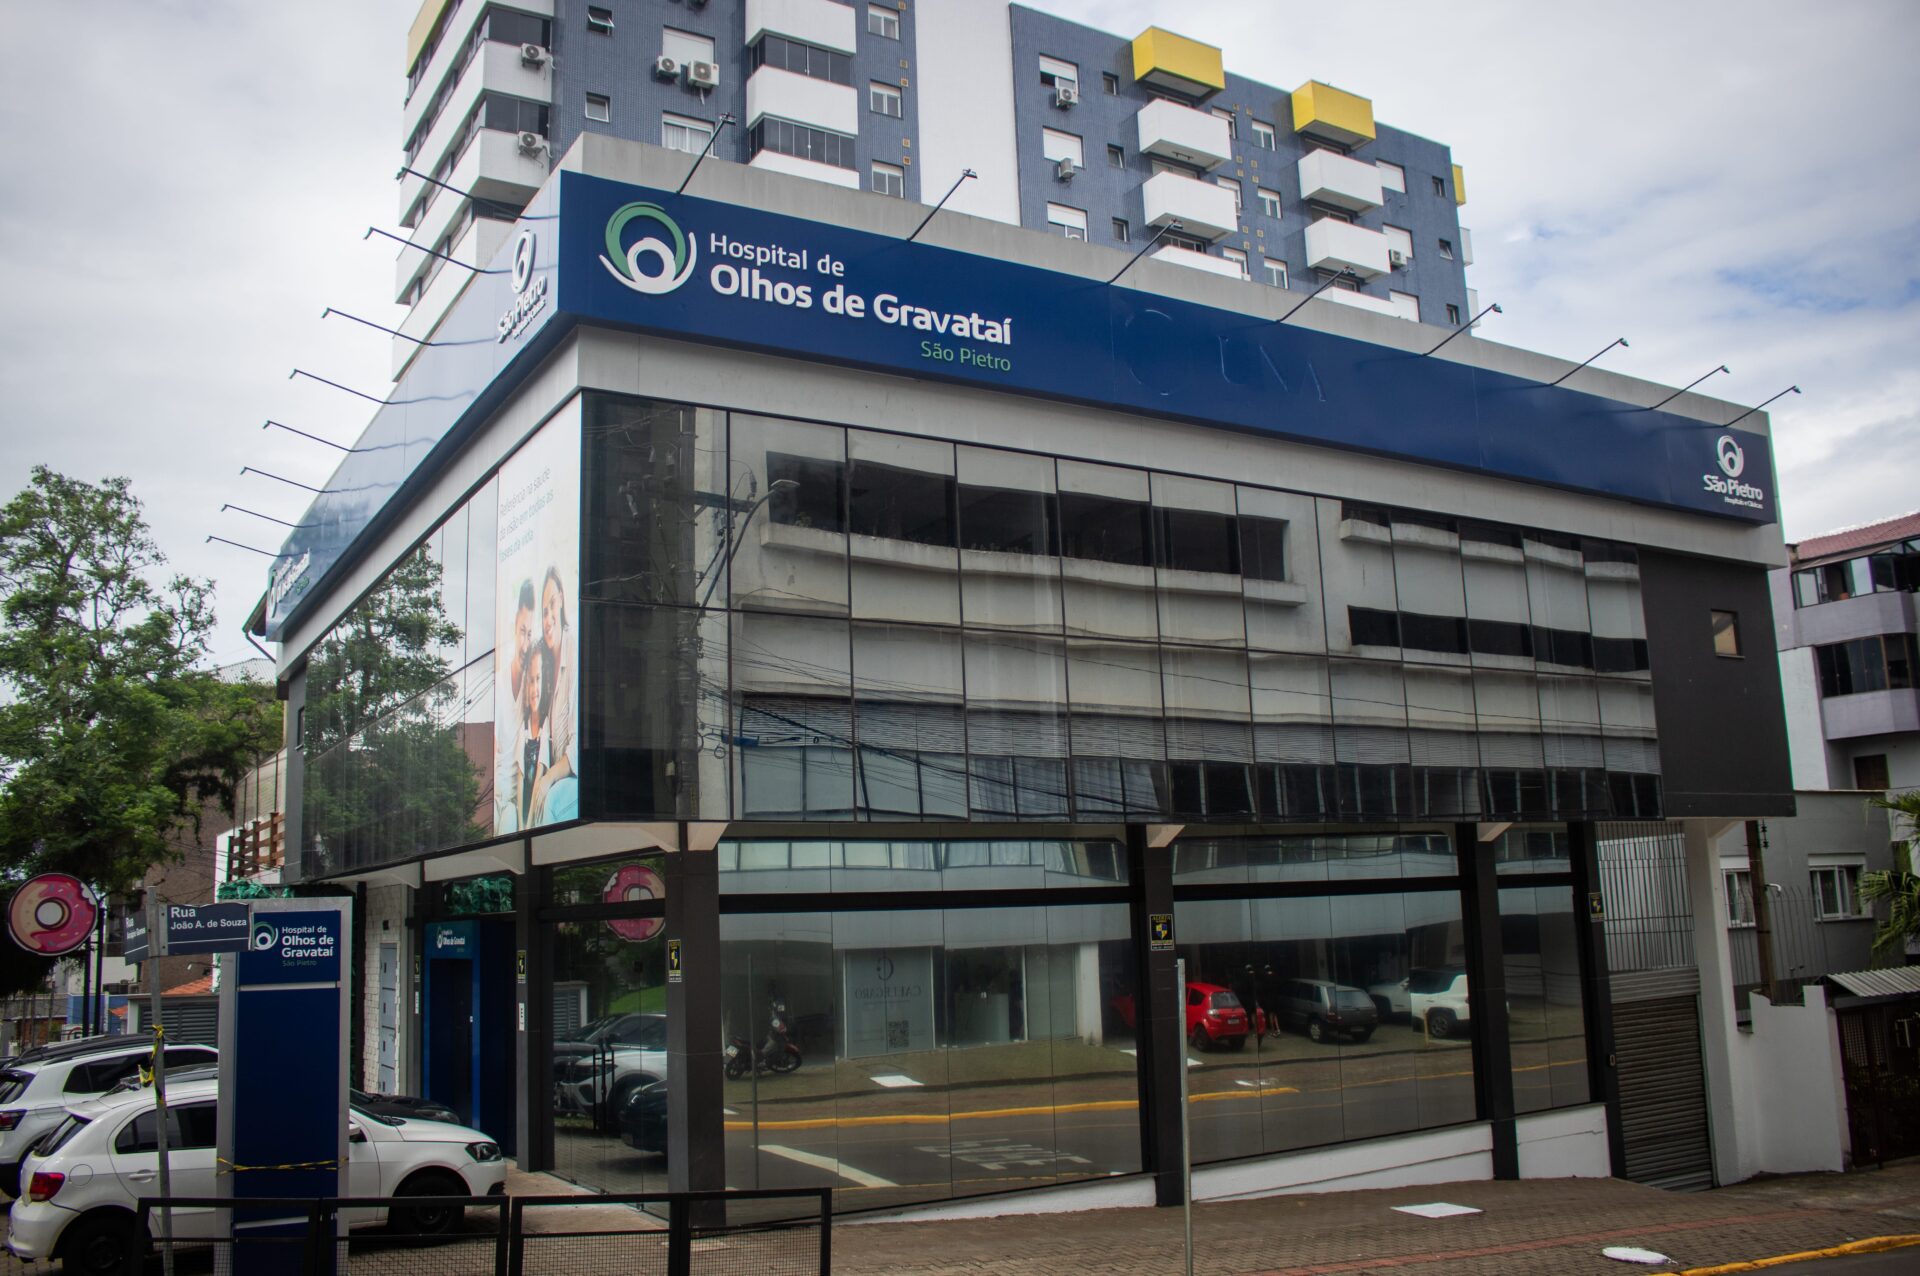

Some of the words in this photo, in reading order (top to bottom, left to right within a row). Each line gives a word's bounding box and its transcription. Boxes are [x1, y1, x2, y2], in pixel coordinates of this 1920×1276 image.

[711, 232, 808, 271] Hospital
[817, 253, 846, 277] de
[710, 263, 813, 309] Olhos
[822, 283, 866, 318] de
[873, 293, 1013, 345] Gravataí
[920, 340, 955, 363] São
[959, 347, 1012, 373] Pietro
[1704, 474, 1727, 493] São
[1727, 479, 1763, 500] Pietro
[170, 906, 197, 918] Rua
[170, 921, 194, 931] João
[195, 921, 205, 929] A.
[207, 919, 218, 929] de
[220, 918, 247, 928] Souza
[281, 926, 315, 935] Hospital
[317, 925, 328, 933] de
[281, 935, 316, 946] Olhos
[318, 934, 334, 945] de
[281, 946, 334, 958] Gravataí
